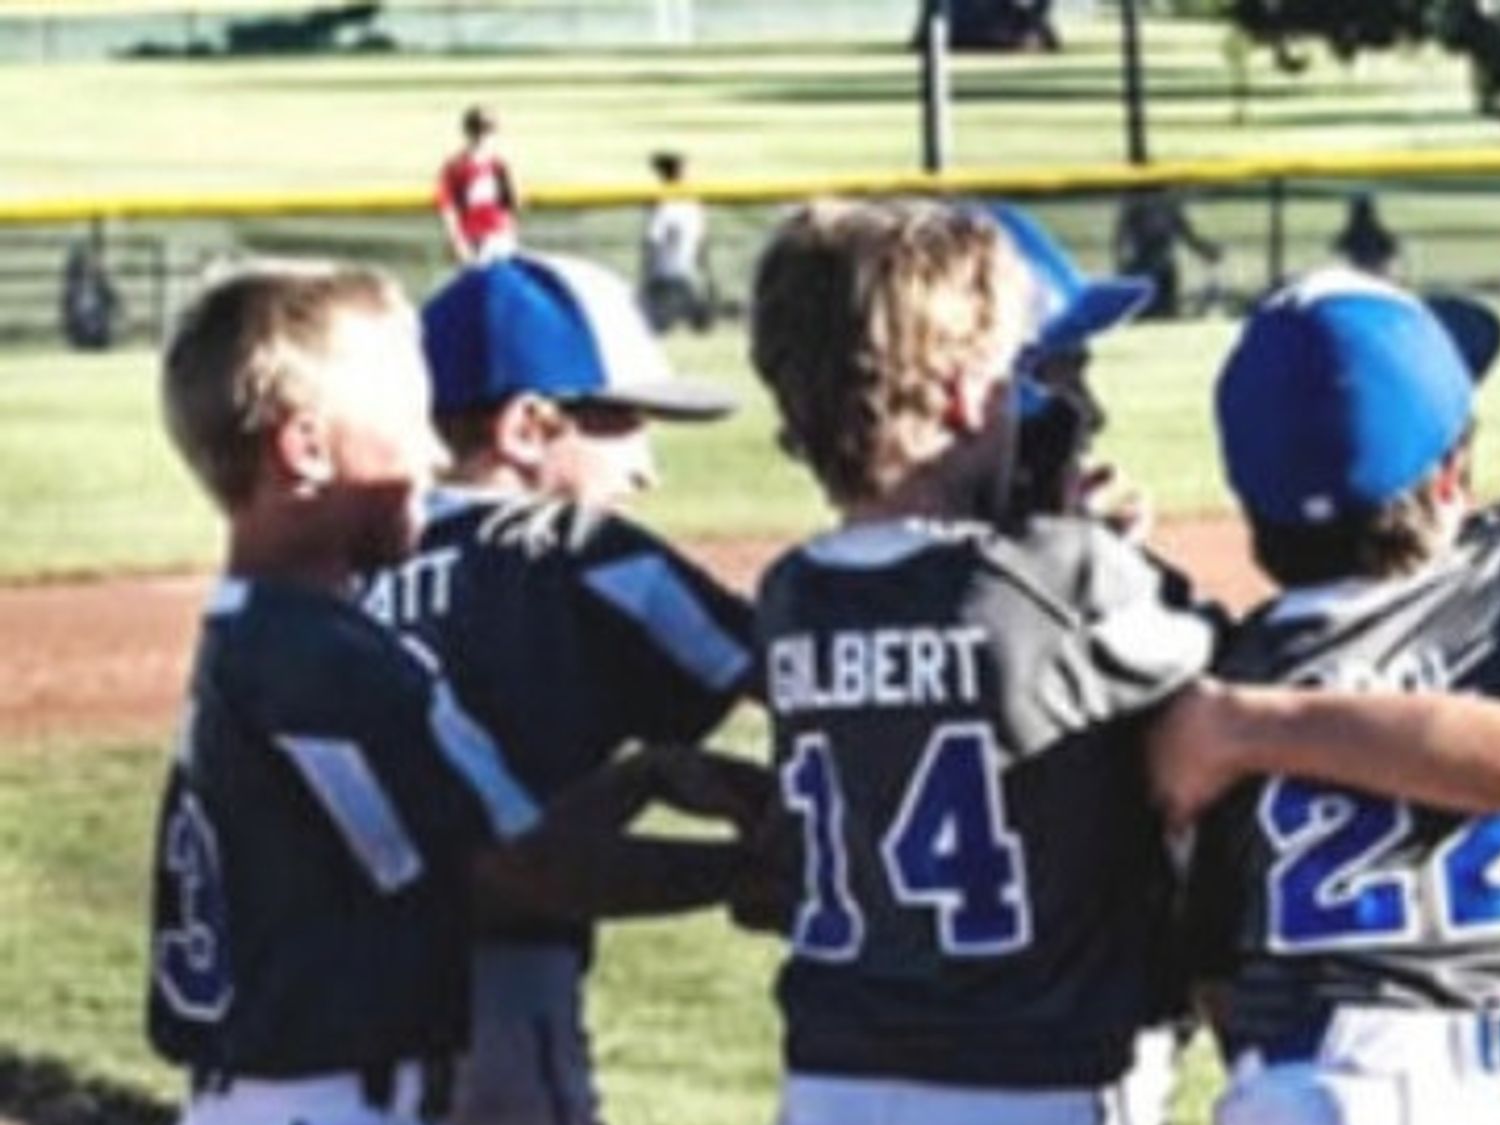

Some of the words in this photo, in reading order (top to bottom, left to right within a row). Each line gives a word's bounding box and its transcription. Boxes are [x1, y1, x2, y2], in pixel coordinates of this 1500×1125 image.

[350, 545, 463, 628] ATT
[768, 626, 989, 716] GILBERT
[779, 720, 1032, 962] 14
